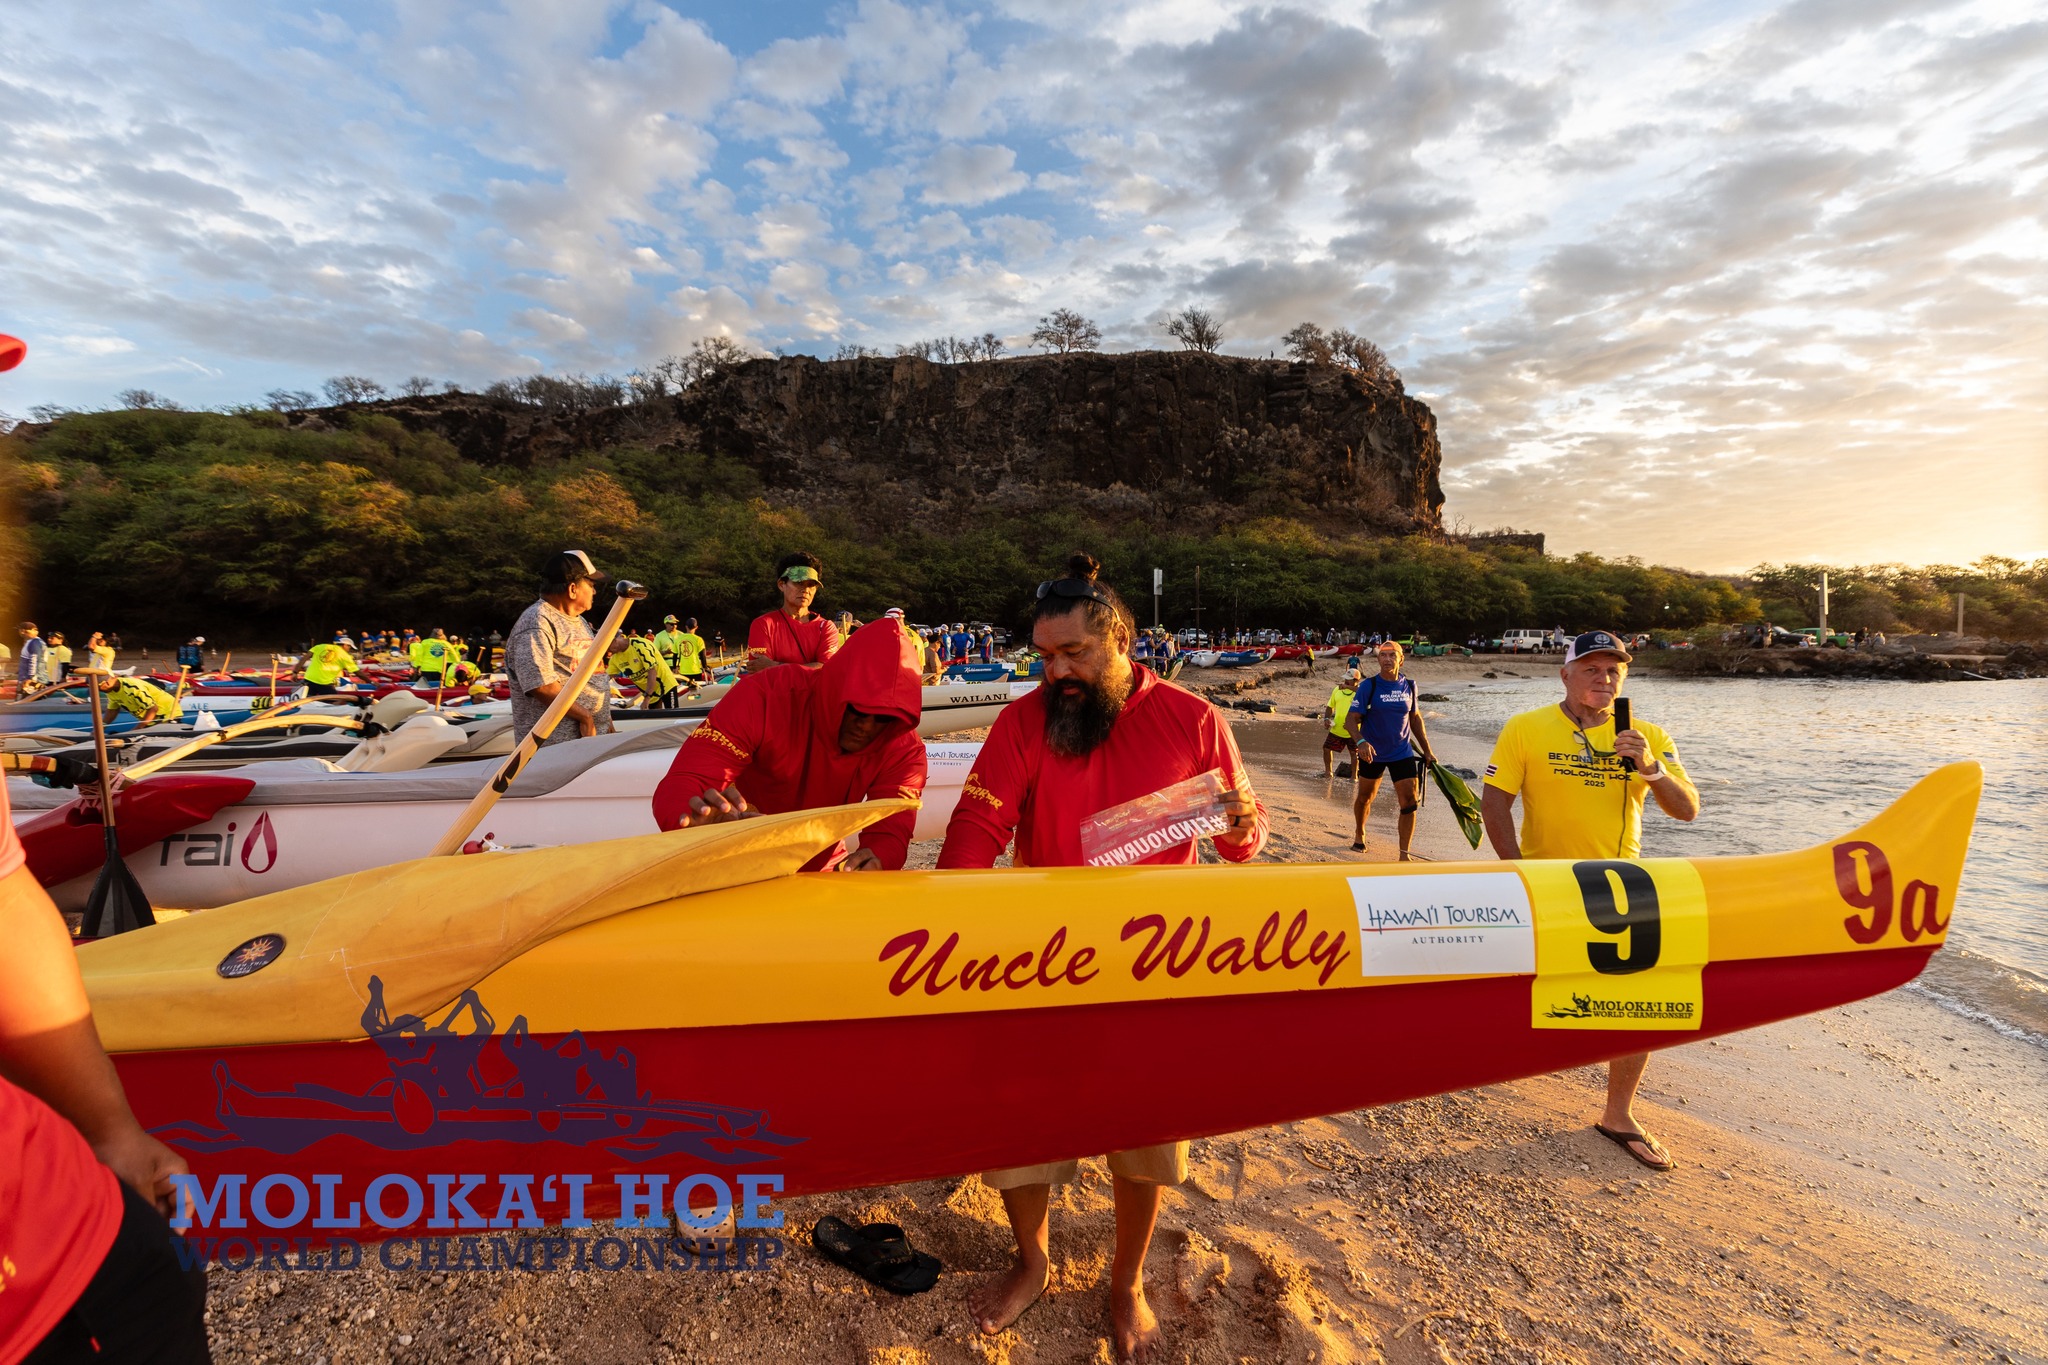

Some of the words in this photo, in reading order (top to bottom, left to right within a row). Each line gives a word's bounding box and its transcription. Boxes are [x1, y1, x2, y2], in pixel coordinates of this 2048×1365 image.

[950, 693, 1008, 704] WAILANI
[948, 751, 977, 759] TOURISM
[1608, 773, 1632, 782] HOE
[1584, 779, 1606, 788] 2025
[1832, 841, 1949, 945] 9a
[1367, 902, 1439, 935] HAWAI'I
[1443, 905, 1520, 925] TOURISM
[1572, 860, 1661, 976] 9
[1411, 935, 1485, 945] AUTHORITY
[878, 926, 1100, 997] Uncle
[1120, 908, 1350, 986] Wally
[1593, 1000, 1662, 1012] MOLOKA‘I
[1665, 1002, 1694, 1013] HOE
[1593, 1010, 1625, 1018] WORLD
[1626, 1011, 1694, 1020] CHAMPIONSHIP
